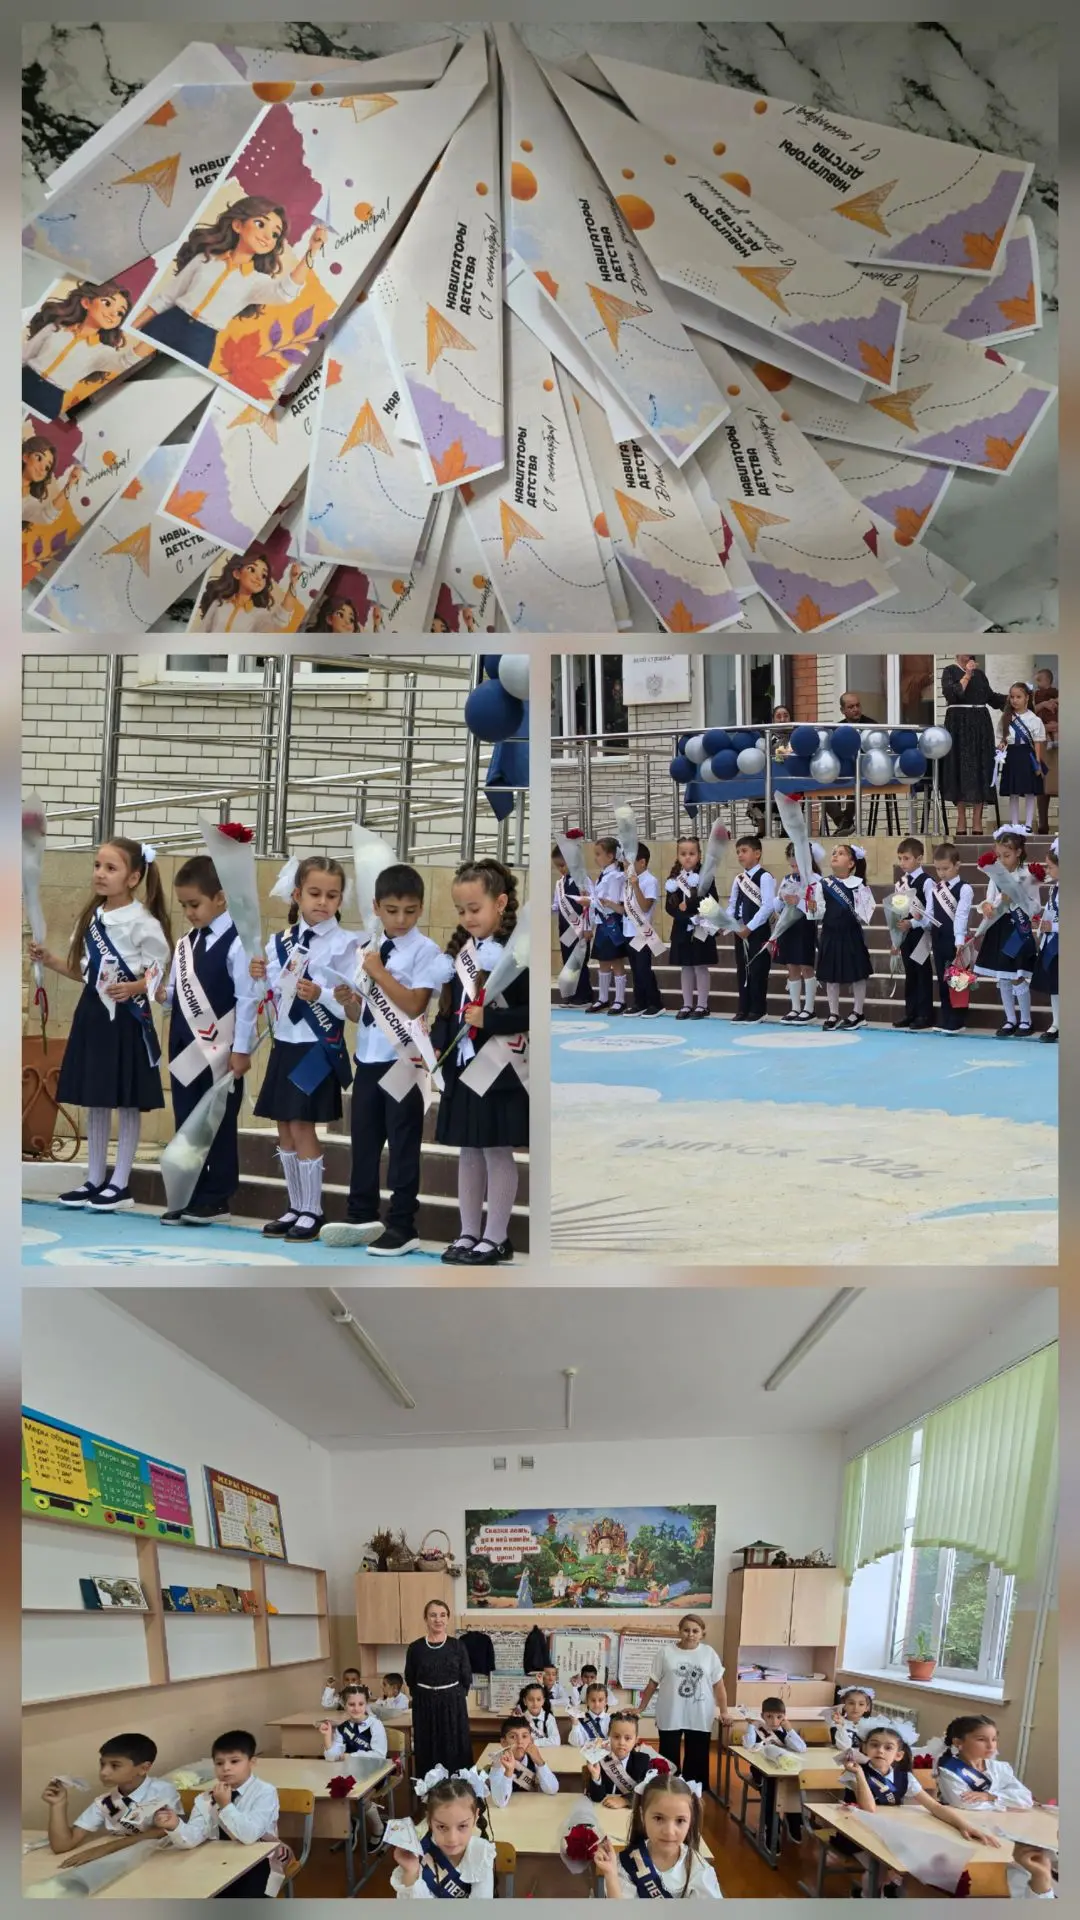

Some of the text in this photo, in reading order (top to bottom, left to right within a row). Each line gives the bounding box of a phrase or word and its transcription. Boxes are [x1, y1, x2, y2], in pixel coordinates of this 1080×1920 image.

[779, 139, 852, 193] НАВИГАТОРЫ
[812, 142, 865, 181] ДЕТСТВА
[860, 148, 881, 161] С
[579, 198, 612, 283] НАВИГАТОРЫ
[683, 192, 752, 258] НАВИГАТОРЫ
[715, 207, 764, 252] ДЕТСТВА
[446, 221, 468, 310] НАВИГАТОРЫ
[600, 226, 628, 283] ДЕТСТВА
[459, 255, 477, 316] ДЕТСТВА
[635, 299, 654, 314] С
[477, 305, 494, 321] С
[514, 426, 528, 504] НАВИГАТОРЫ
[526, 454, 538, 509] ДЕТСТВА
[618, 440, 637, 489] НАВИГА
[725, 425, 755, 497] НАВИГАТОРЫ
[746, 447, 772, 497] ДЕТСТВА
[542, 498, 558, 512] С
[658, 505, 676, 518] С
[775, 483, 795, 494] С
[159, 527, 191, 546] НАВИ
[176, 559, 184, 574] С
[369, 982, 414, 1048] ОКЛАССНИК
[443, 1879, 470, 1898] ПЕР
